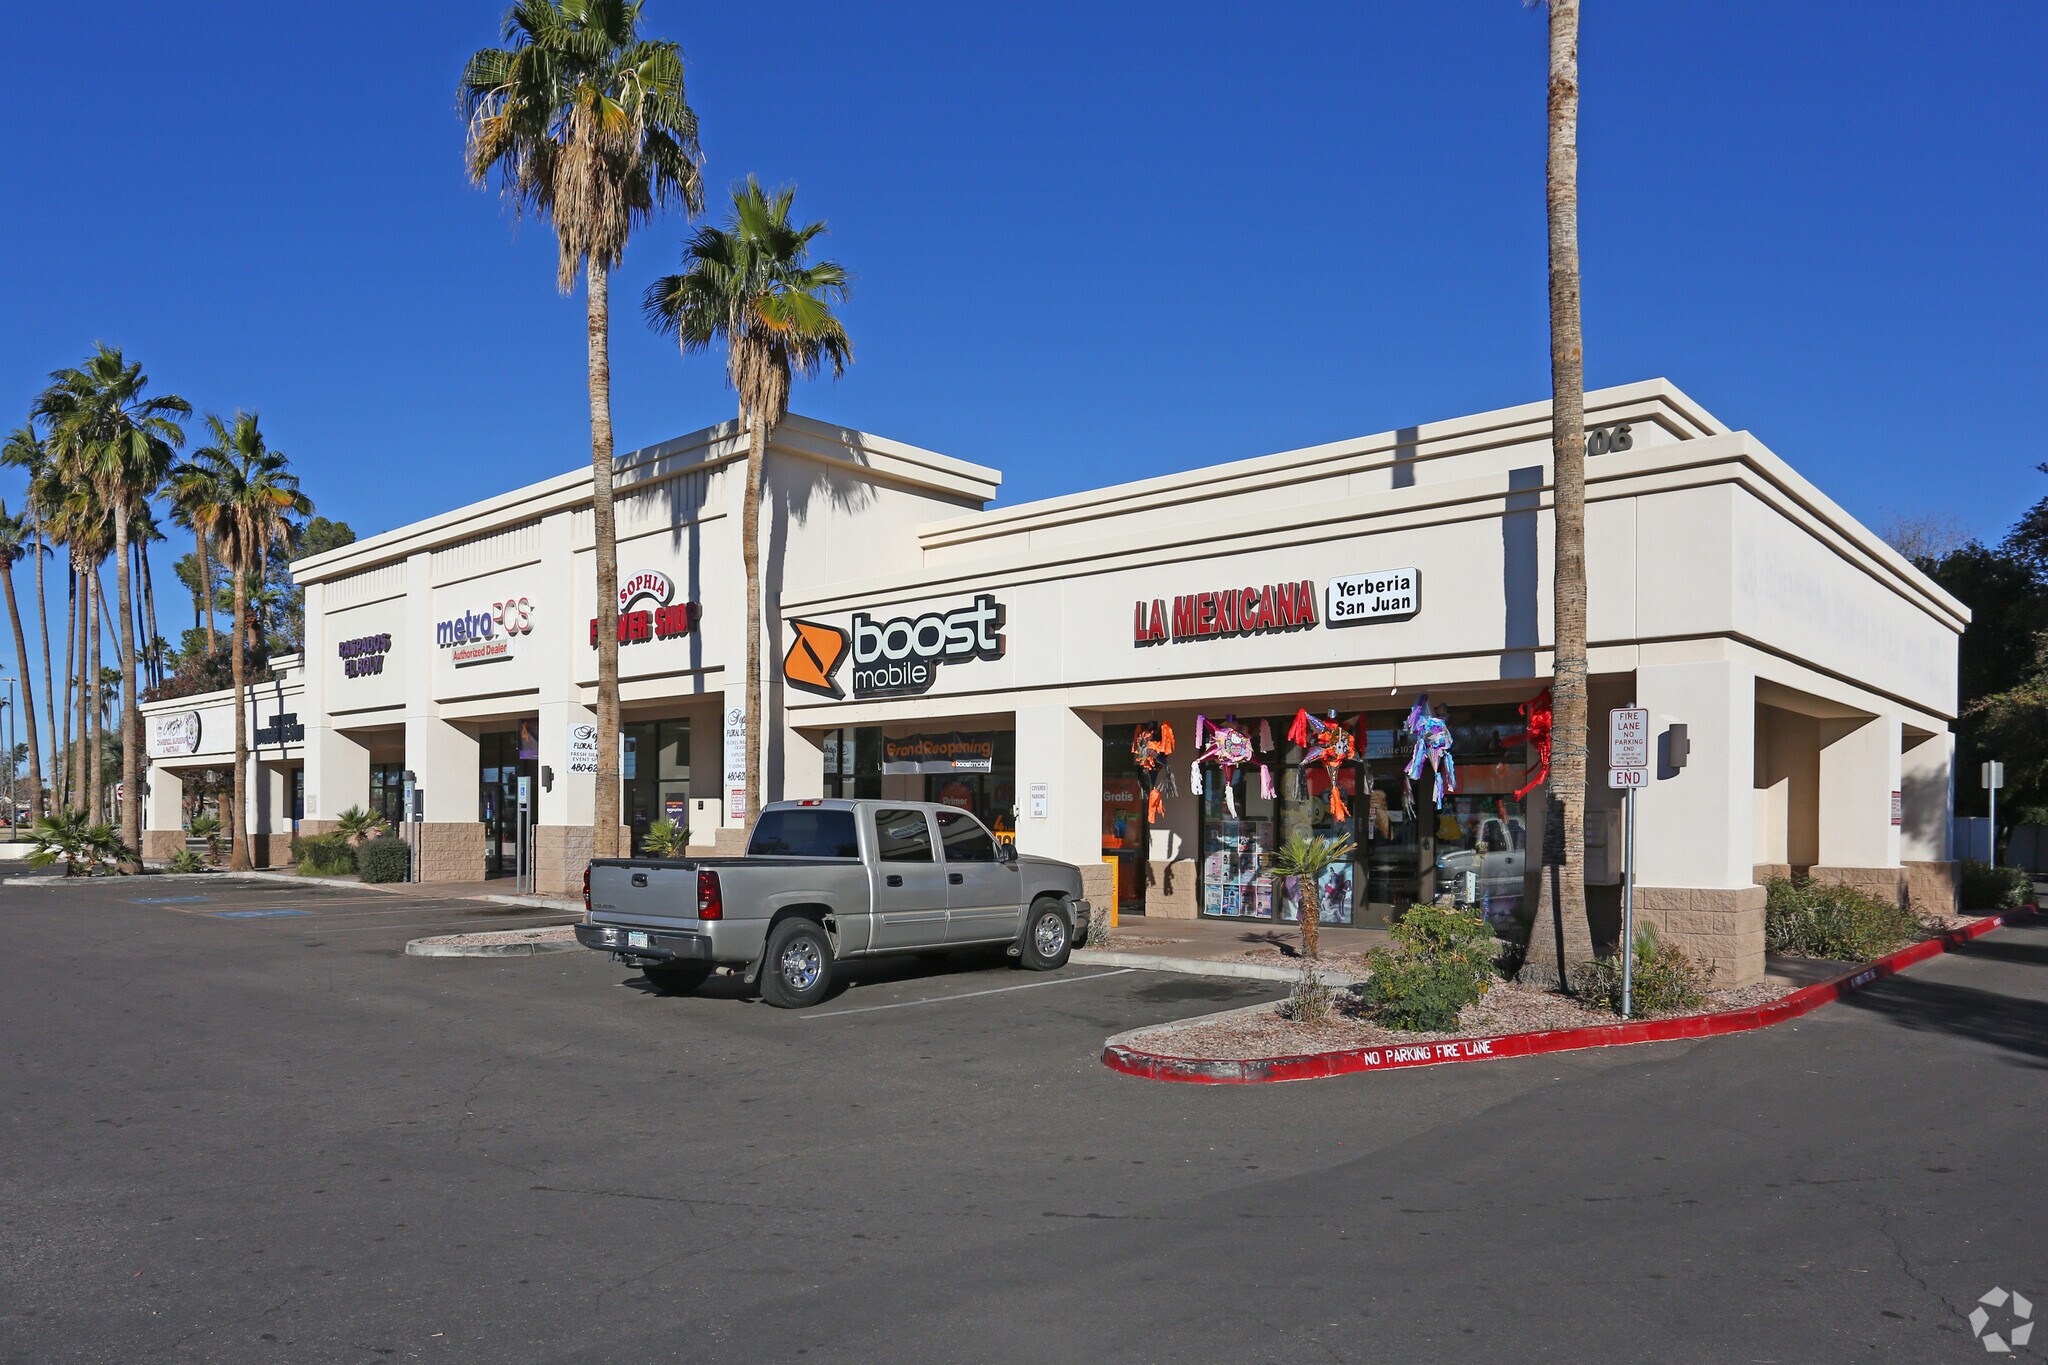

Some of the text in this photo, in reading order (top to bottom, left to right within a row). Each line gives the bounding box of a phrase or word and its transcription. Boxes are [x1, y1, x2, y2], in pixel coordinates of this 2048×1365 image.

[1583, 422, 1634, 457] 06
[618, 574, 666, 604] SOPHIA
[1337, 575, 1411, 597] Yerberia
[1135, 580, 1317, 644] LA MEXICANA
[1336, 595, 1411, 617] San Juan
[436, 597, 534, 647] metroPCS
[589, 601, 702, 649] FWER SHOP
[853, 598, 997, 665] boost
[453, 643, 508, 661] Authorized Dealer
[855, 663, 928, 691] mobile
[1619, 712, 1639, 720] FIRE
[1617, 722, 1640, 731] LANE
[573, 742, 593, 750] FLORAL
[887, 740, 991, 757] Grand Reopening
[1378, 745, 1400, 754] Suite
[1614, 738, 1644, 746] PARKING
[571, 763, 598, 773] 480-62
[1616, 771, 1641, 785] END
[943, 796, 968, 805] Primer
[1103, 791, 1134, 801] Gratis
[1364, 1040, 1493, 1066] NO PARKING FIRE LANE
